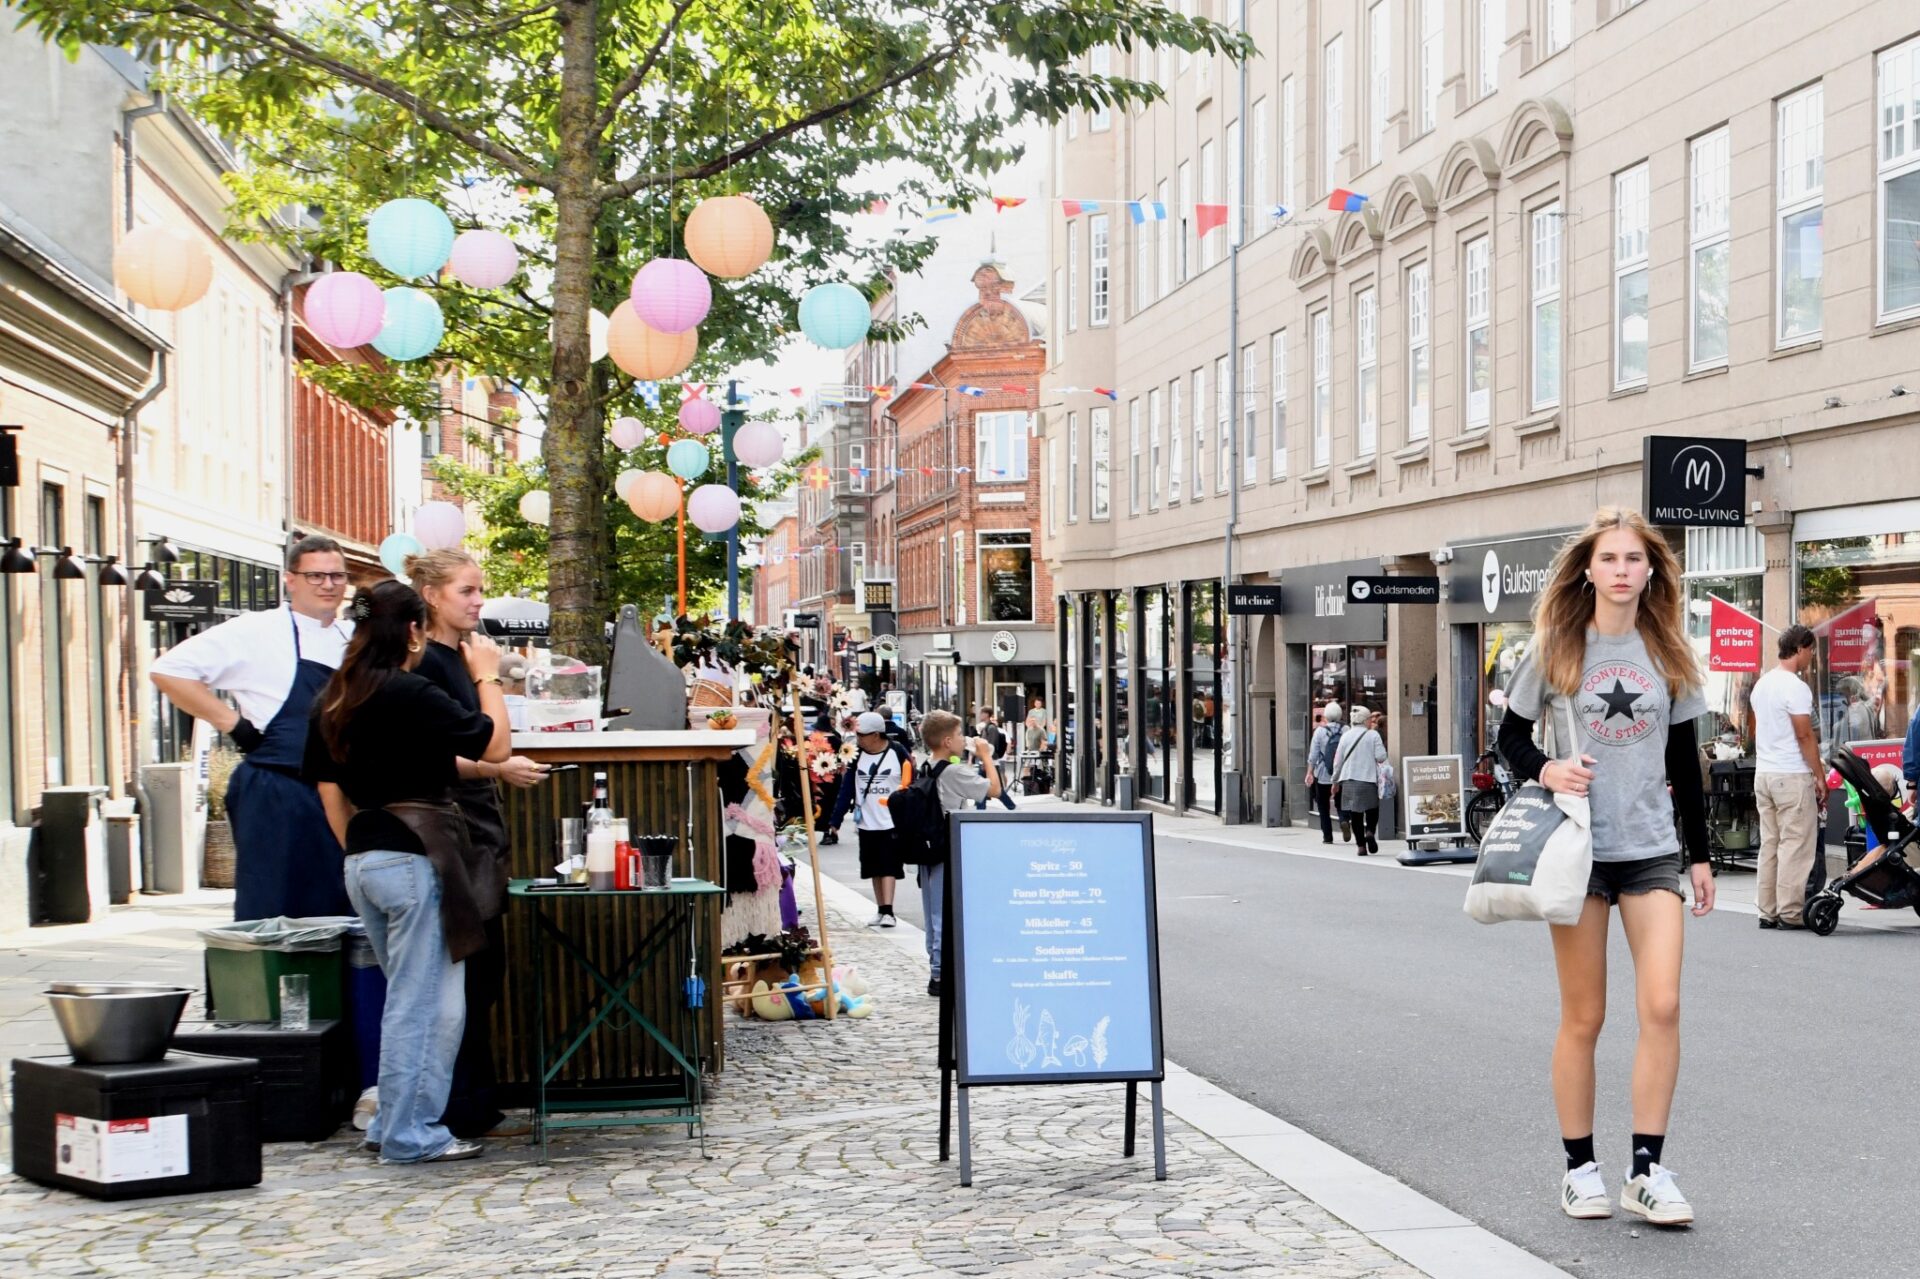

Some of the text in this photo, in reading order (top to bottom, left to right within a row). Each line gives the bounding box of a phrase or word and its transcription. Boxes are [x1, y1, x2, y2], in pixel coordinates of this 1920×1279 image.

[1685, 458, 1710, 491] M
[1656, 507, 1740, 520] MILTO-LIVING
[1373, 584, 1435, 595] Guldsmedien
[1235, 595, 1275, 606] lift clinic
[1315, 584, 1346, 617] lift clinic
[1715, 627, 1754, 638] genbrug
[1720, 637, 1754, 647] til børn
[1584, 667, 1653, 692] CONVERSE
[1582, 703, 1606, 714] Chuck
[1590, 719, 1649, 739] ALL STAR
[1876, 751, 1886, 759] du
[1433, 772, 1452, 780] GULD
[1030, 861, 1060, 872] Spritz
[1039, 888, 1080, 899] Bryghus
[1088, 888, 1102, 897] 70
[1025, 917, 1071, 927] Mikkeller
[1079, 917, 1093, 927] 45
[1035, 945, 1085, 955] Sodavand
[1043, 970, 1079, 980] Iskaffe
